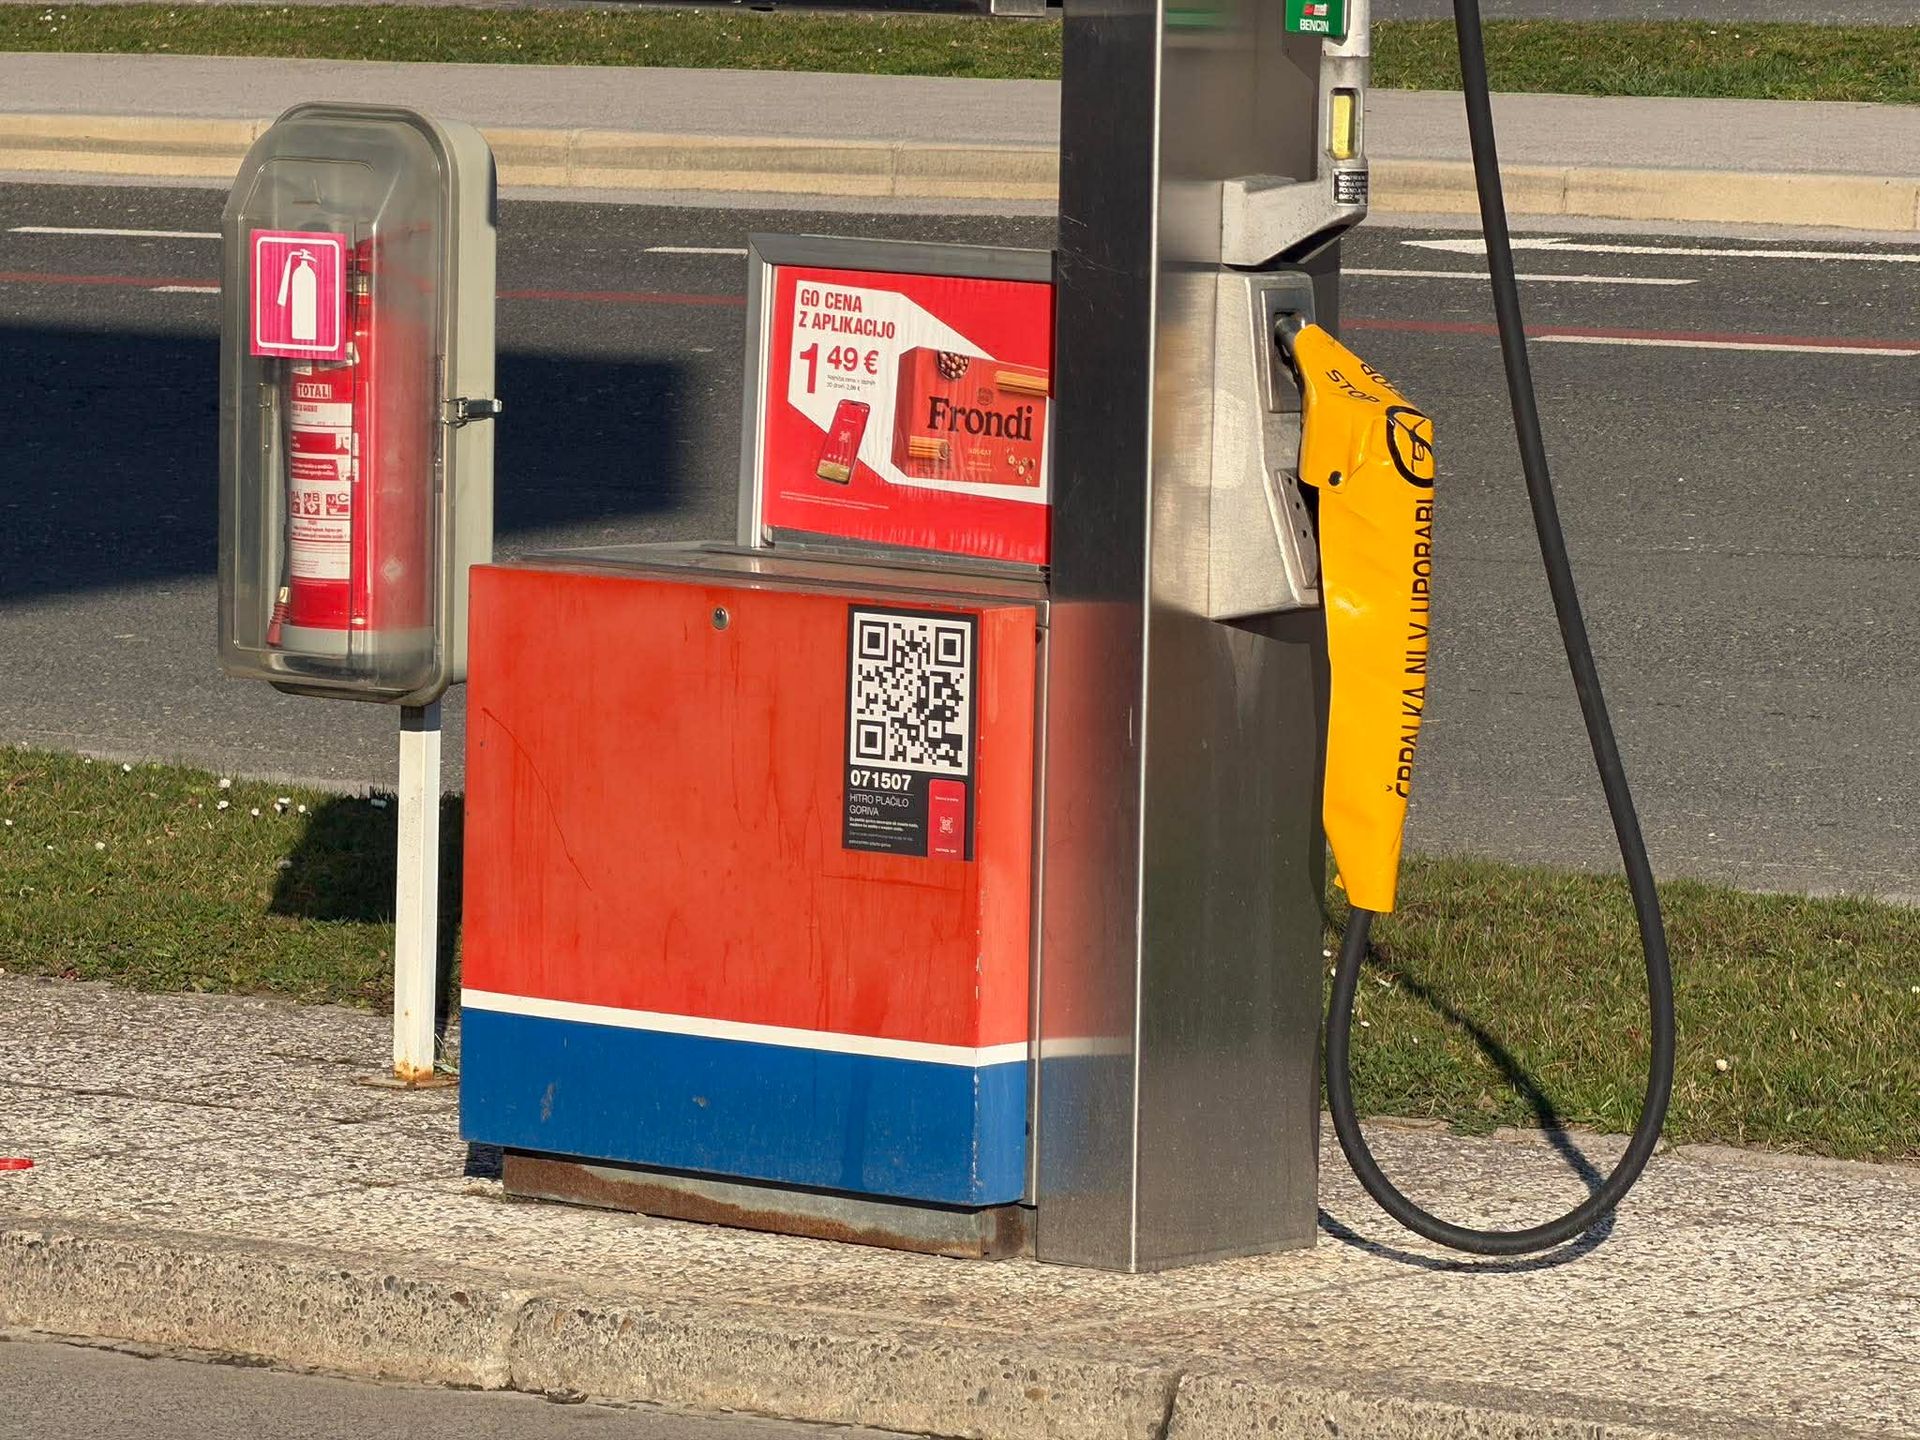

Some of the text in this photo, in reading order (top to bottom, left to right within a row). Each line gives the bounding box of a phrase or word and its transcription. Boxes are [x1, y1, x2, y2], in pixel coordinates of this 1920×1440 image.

[1300, 18, 1329, 32] BENCIN
[801, 288, 863, 313] GO CENA
[798, 310, 896, 340] Z APLIKACIJO
[799, 342, 819, 394] 1
[826, 345, 859, 372] 49
[299, 384, 328, 398] TOTAL
[1325, 369, 1381, 404] STOP
[926, 396, 1033, 442] Frondi
[1407, 622, 1429, 640] V
[1404, 650, 1427, 674] NI
[850, 769, 912, 791] 071507
[849, 804, 880, 817] GORIVA
[850, 793, 910, 808] HITRO PLAČILO
